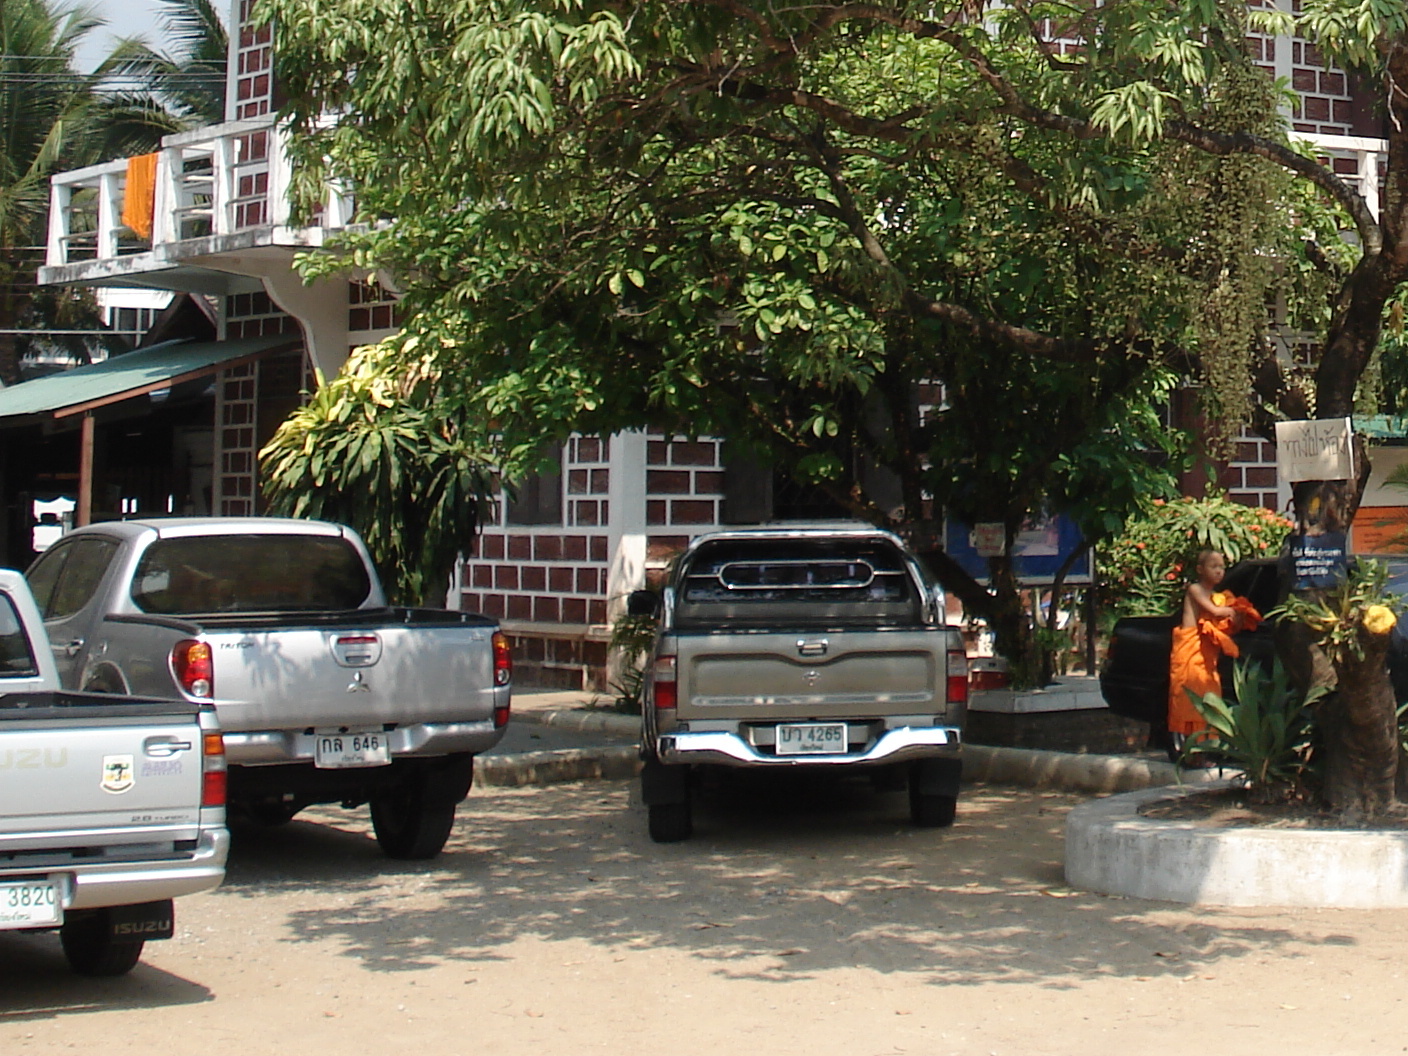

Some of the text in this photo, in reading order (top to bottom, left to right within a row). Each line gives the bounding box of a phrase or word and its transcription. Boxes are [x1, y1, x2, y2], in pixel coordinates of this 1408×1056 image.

[807, 726, 842, 741] 4265
[353, 736, 379, 751] 646
[8, 885, 55, 907] 3820
[114, 920, 171, 934] ISUZU
